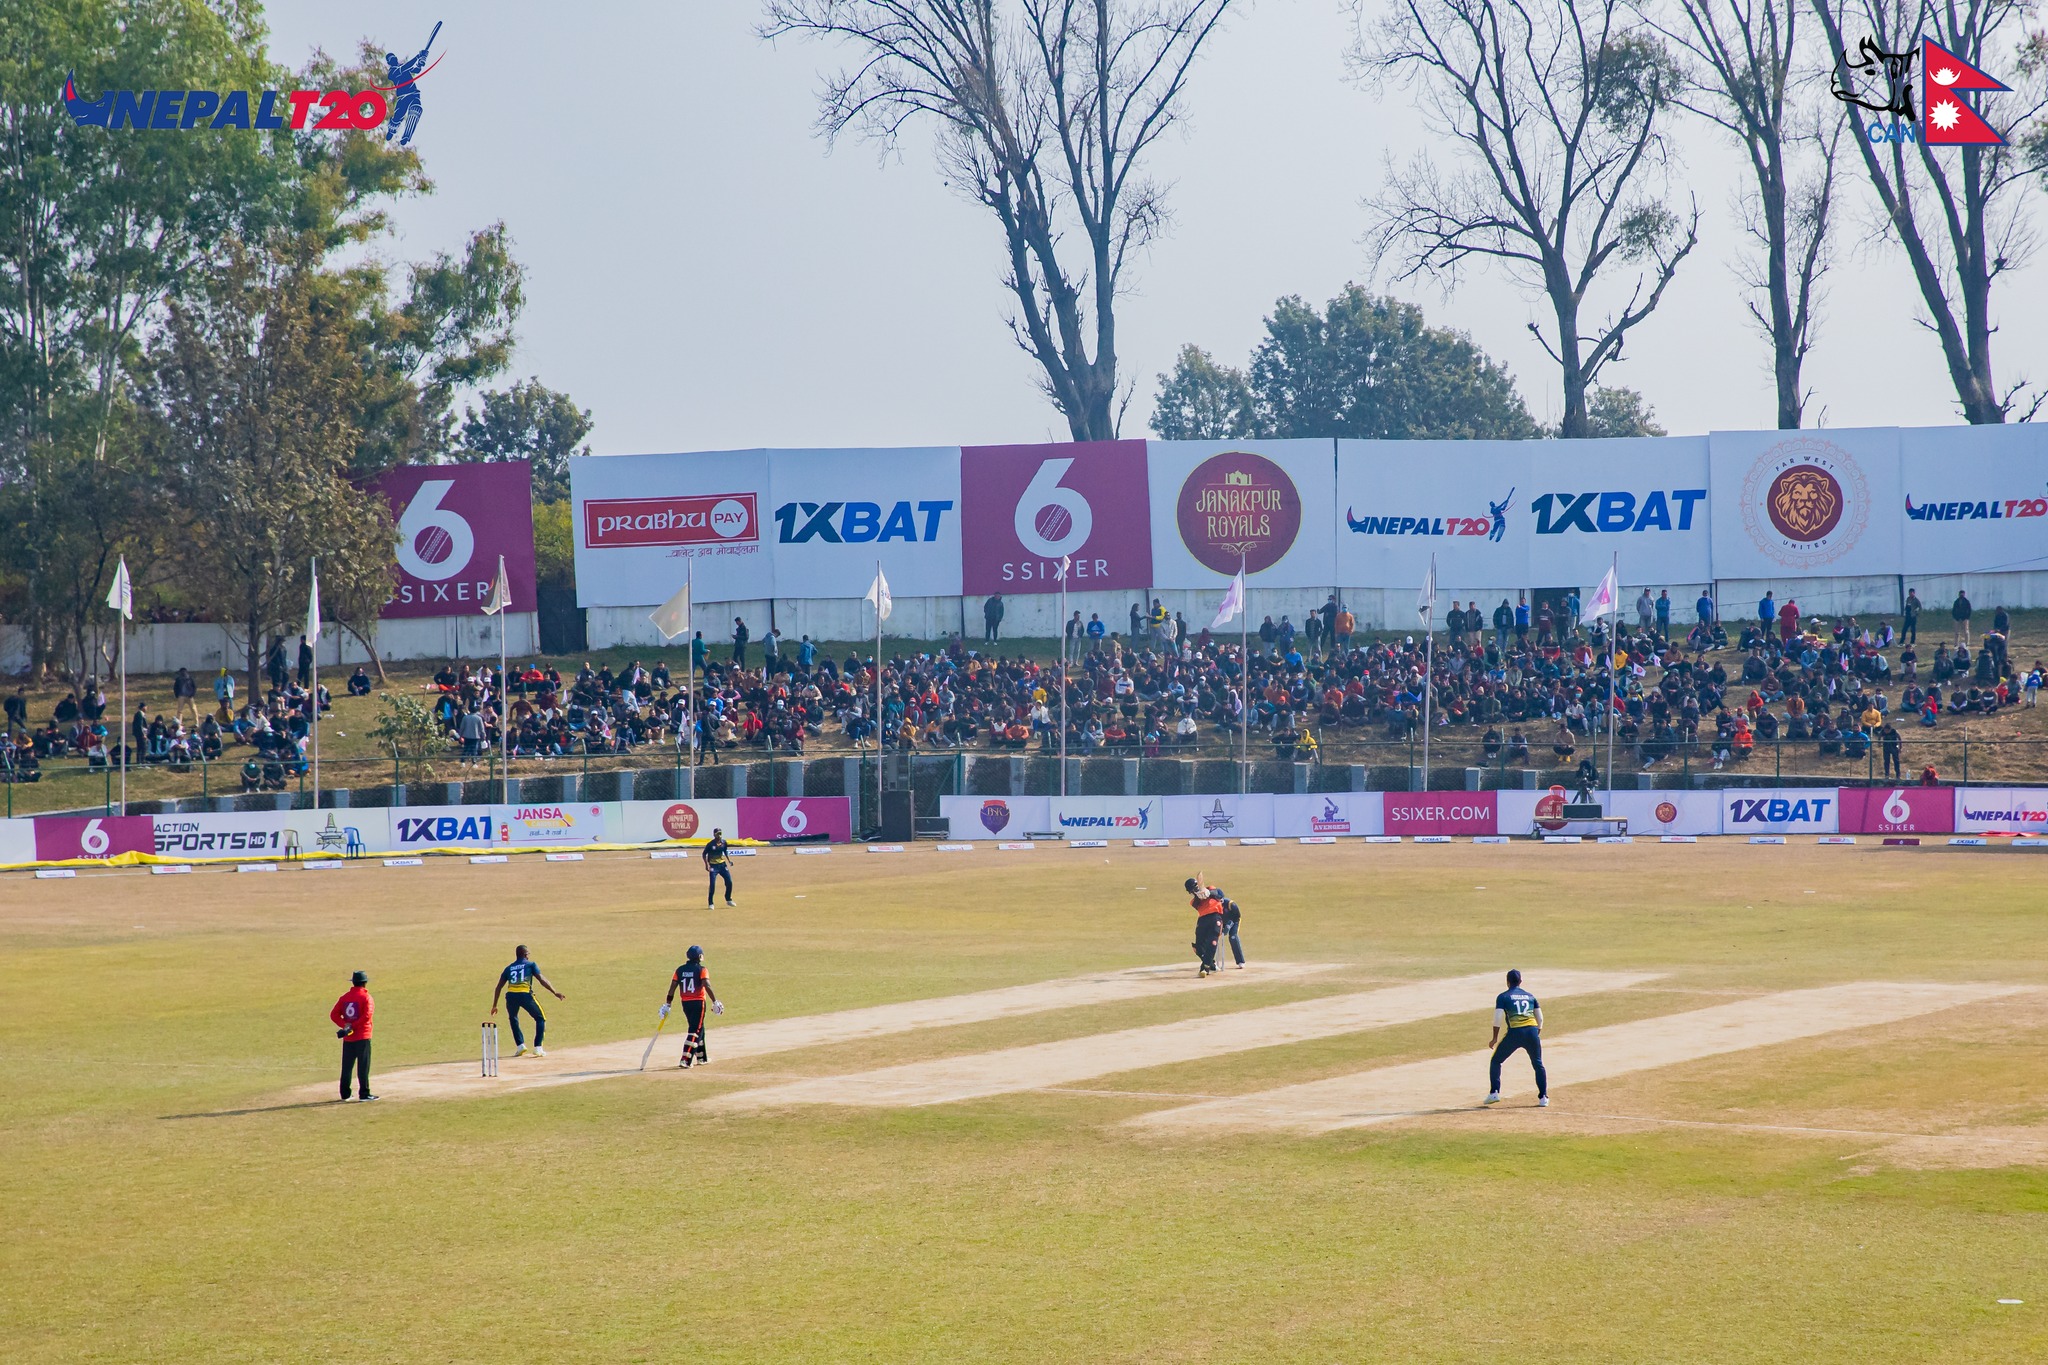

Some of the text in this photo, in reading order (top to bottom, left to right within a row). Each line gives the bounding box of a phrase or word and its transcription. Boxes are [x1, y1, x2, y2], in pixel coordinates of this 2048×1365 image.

[1775, 456, 1834, 472] FAR WEST
[1014, 457, 1093, 559] 6
[1195, 487, 1282, 514] JANAKPUR
[714, 512, 744, 524] PAY
[1531, 489, 1707, 534] 1XBAT
[774, 500, 954, 544] 1XBAT
[1206, 514, 1271, 540] ROYALS
[1782, 539, 1827, 550] UNITED
[1002, 559, 1110, 582] SSIXER
[513, 807, 563, 820] JANSA
[781, 799, 808, 834] 6
[1392, 806, 1490, 821] SSIXER.COM
[1730, 799, 1831, 823] 1XBAT
[1882, 790, 1911, 824] 6
[81, 818, 110, 855] 6
[154, 822, 200, 832] ACTION
[154, 832, 247, 852] SPORTS
[510, 968, 525, 983] 31
[681, 977, 696, 993] 14
[345, 1002, 355, 1017] 6
[1513, 1000, 1530, 1017] 12
